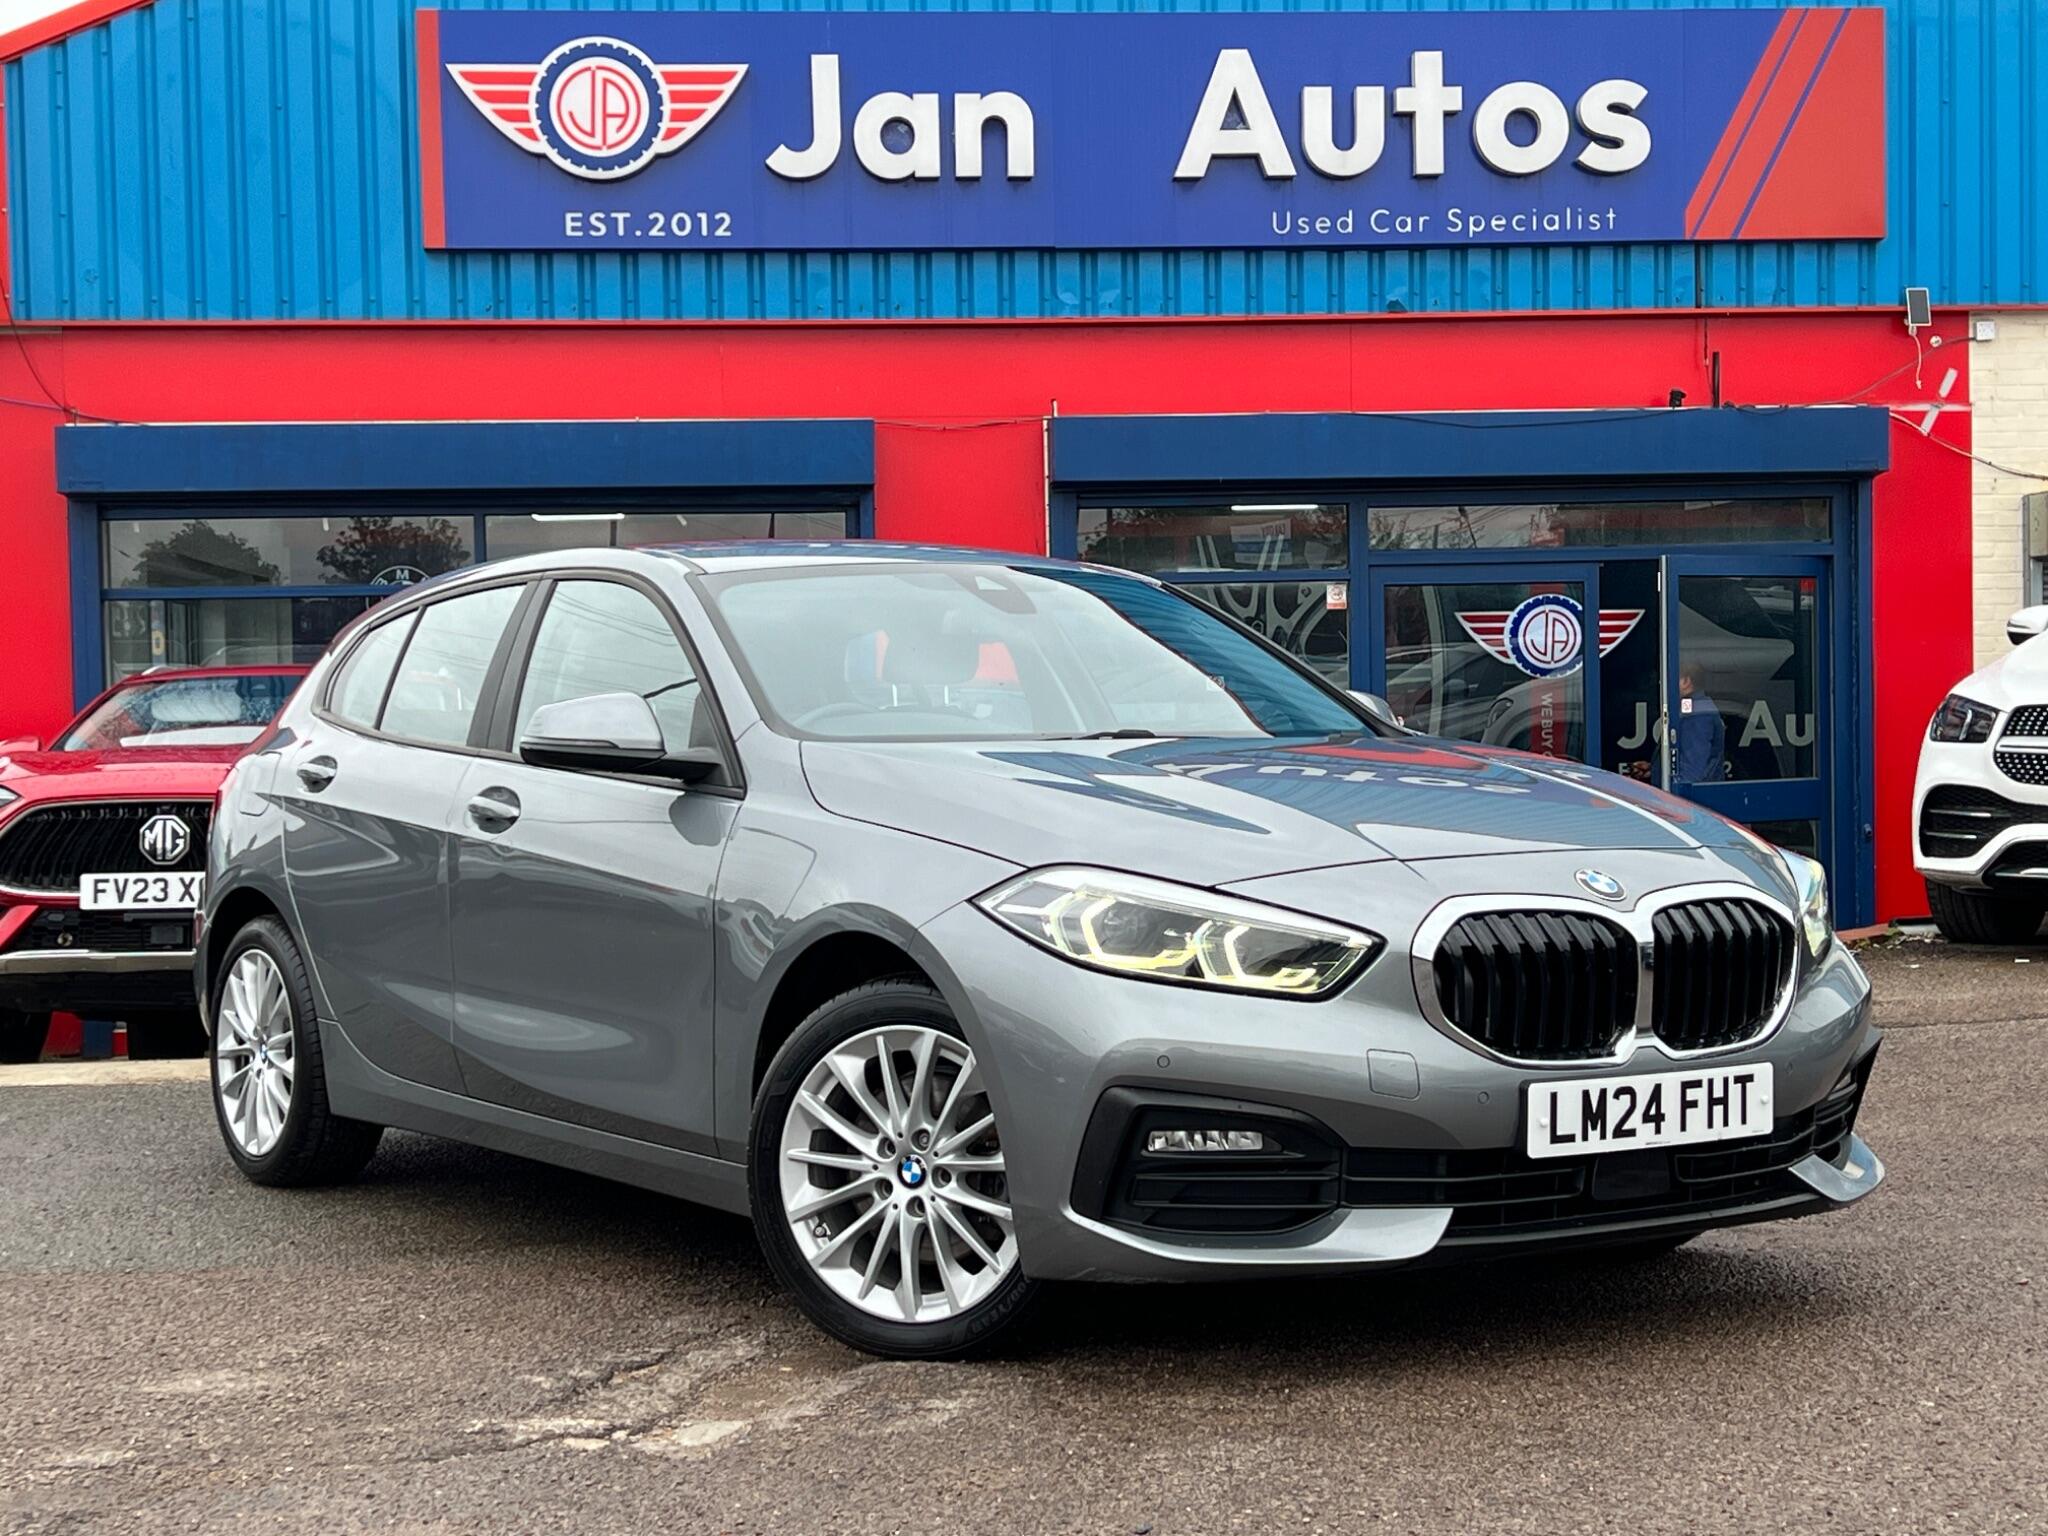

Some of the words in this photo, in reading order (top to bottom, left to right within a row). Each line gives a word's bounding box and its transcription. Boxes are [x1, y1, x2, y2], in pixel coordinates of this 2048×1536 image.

[765, 53, 1034, 180] Jan
[1173, 48, 1652, 180] Autos
[564, 211, 732, 237] EST.2012
[1272, 209, 1353, 234] Used
[1370, 209, 1430, 233] Car
[1447, 207, 1617, 238] Specialist
[142, 818, 187, 862] MG
[93, 877, 169, 904] FV23
[1549, 1082, 1666, 1145] LM24
[1680, 1073, 1755, 1133] FHT
